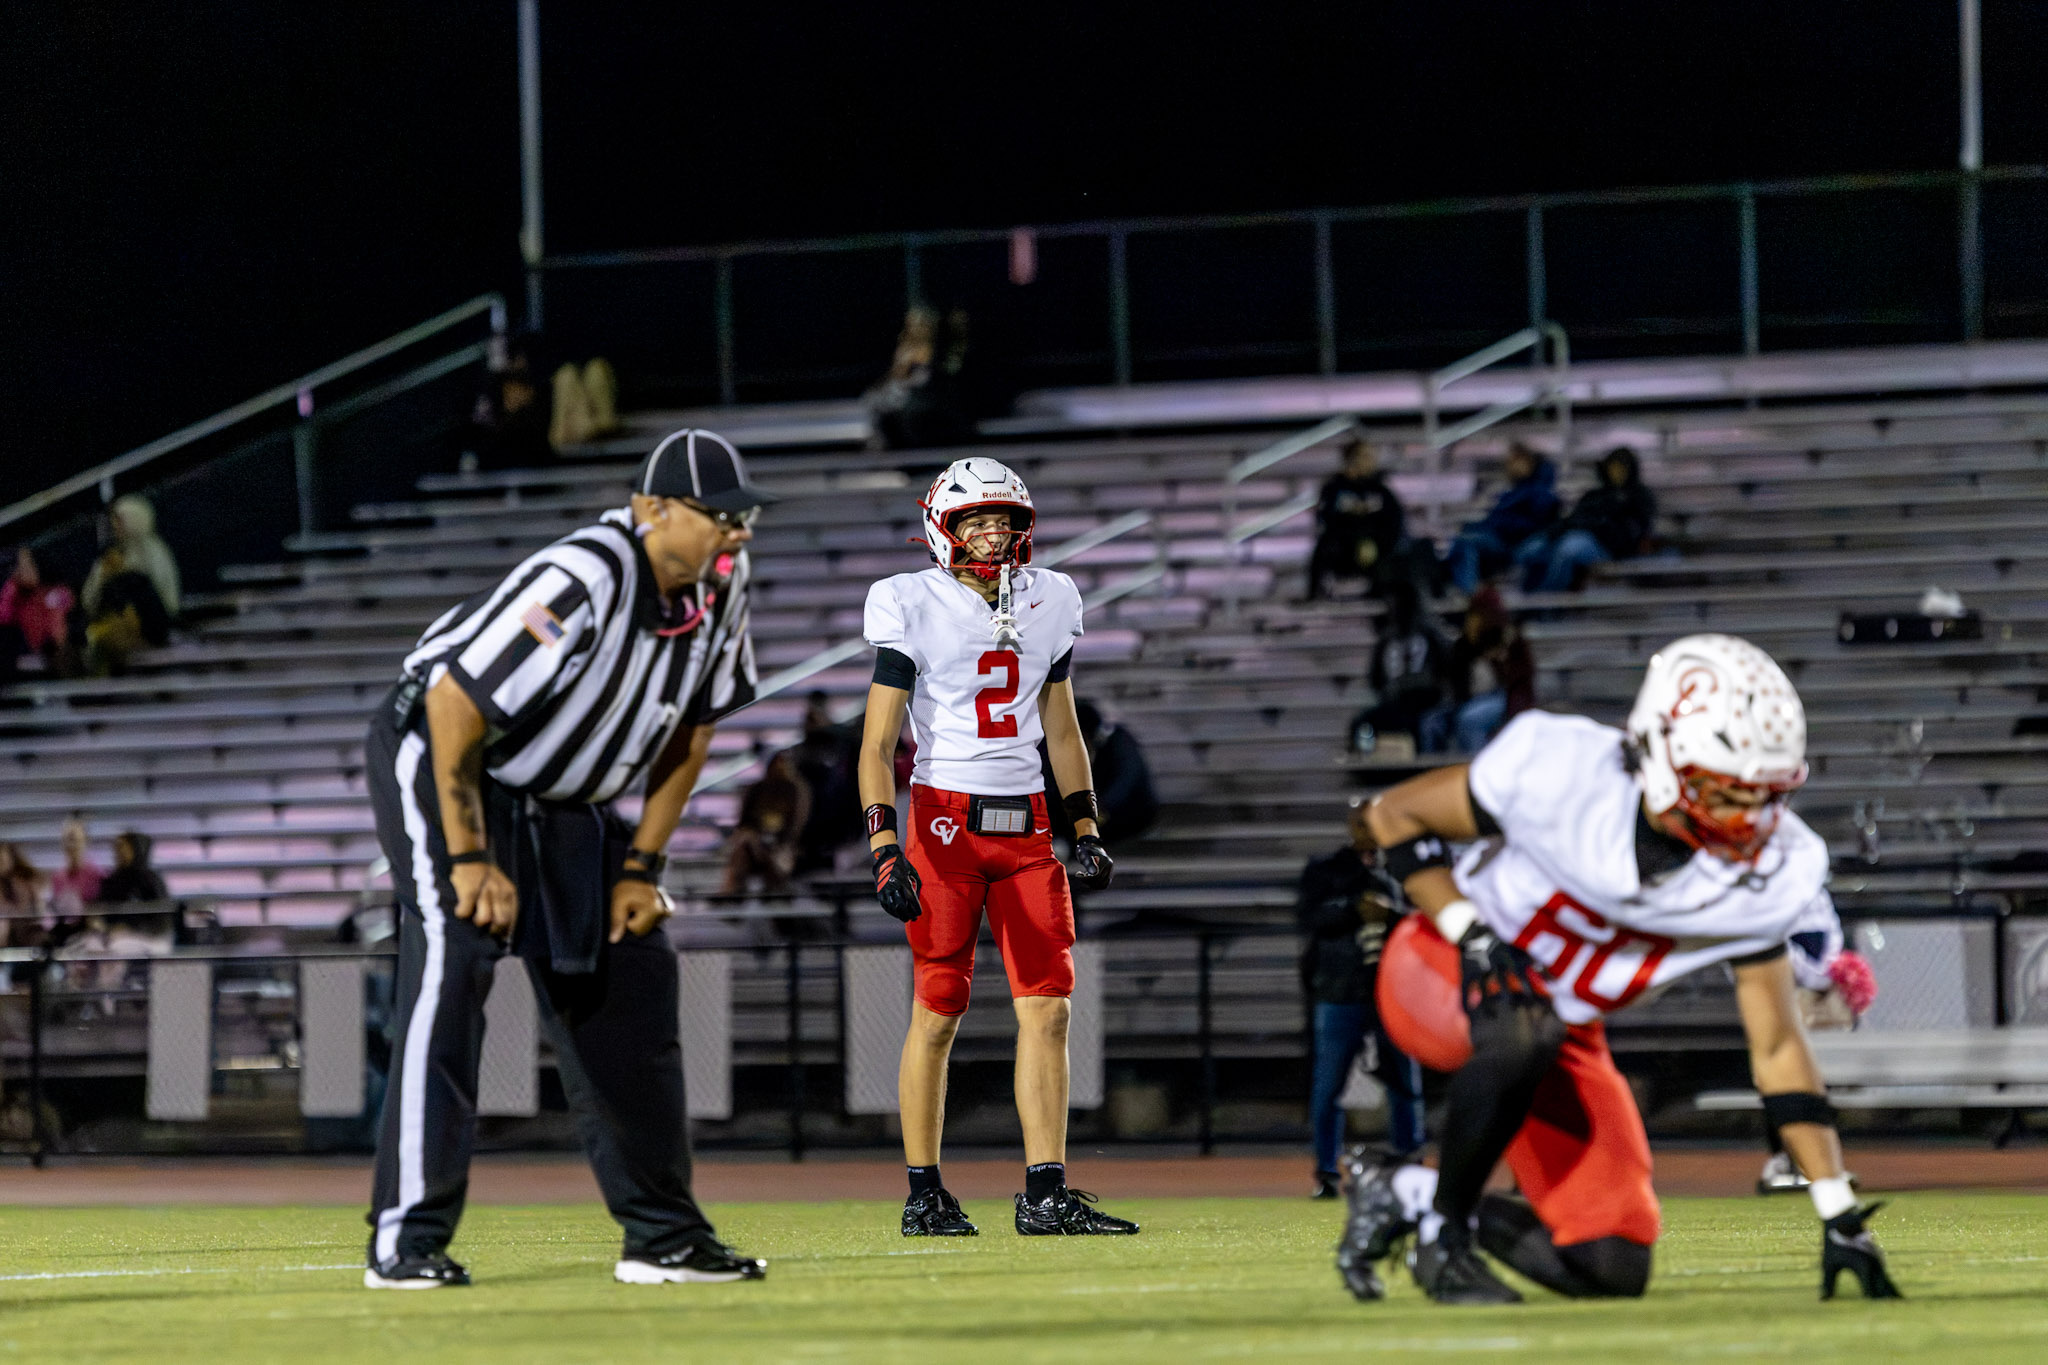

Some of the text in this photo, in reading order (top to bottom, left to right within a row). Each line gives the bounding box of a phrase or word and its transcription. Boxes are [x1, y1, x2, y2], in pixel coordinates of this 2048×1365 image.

[982, 491, 1013, 499] Riddell
[975, 650, 1019, 738] 2
[930, 816, 960, 845] CV
[1513, 889, 1676, 1012] 60
[1029, 1164, 1063, 1173] Supreme
